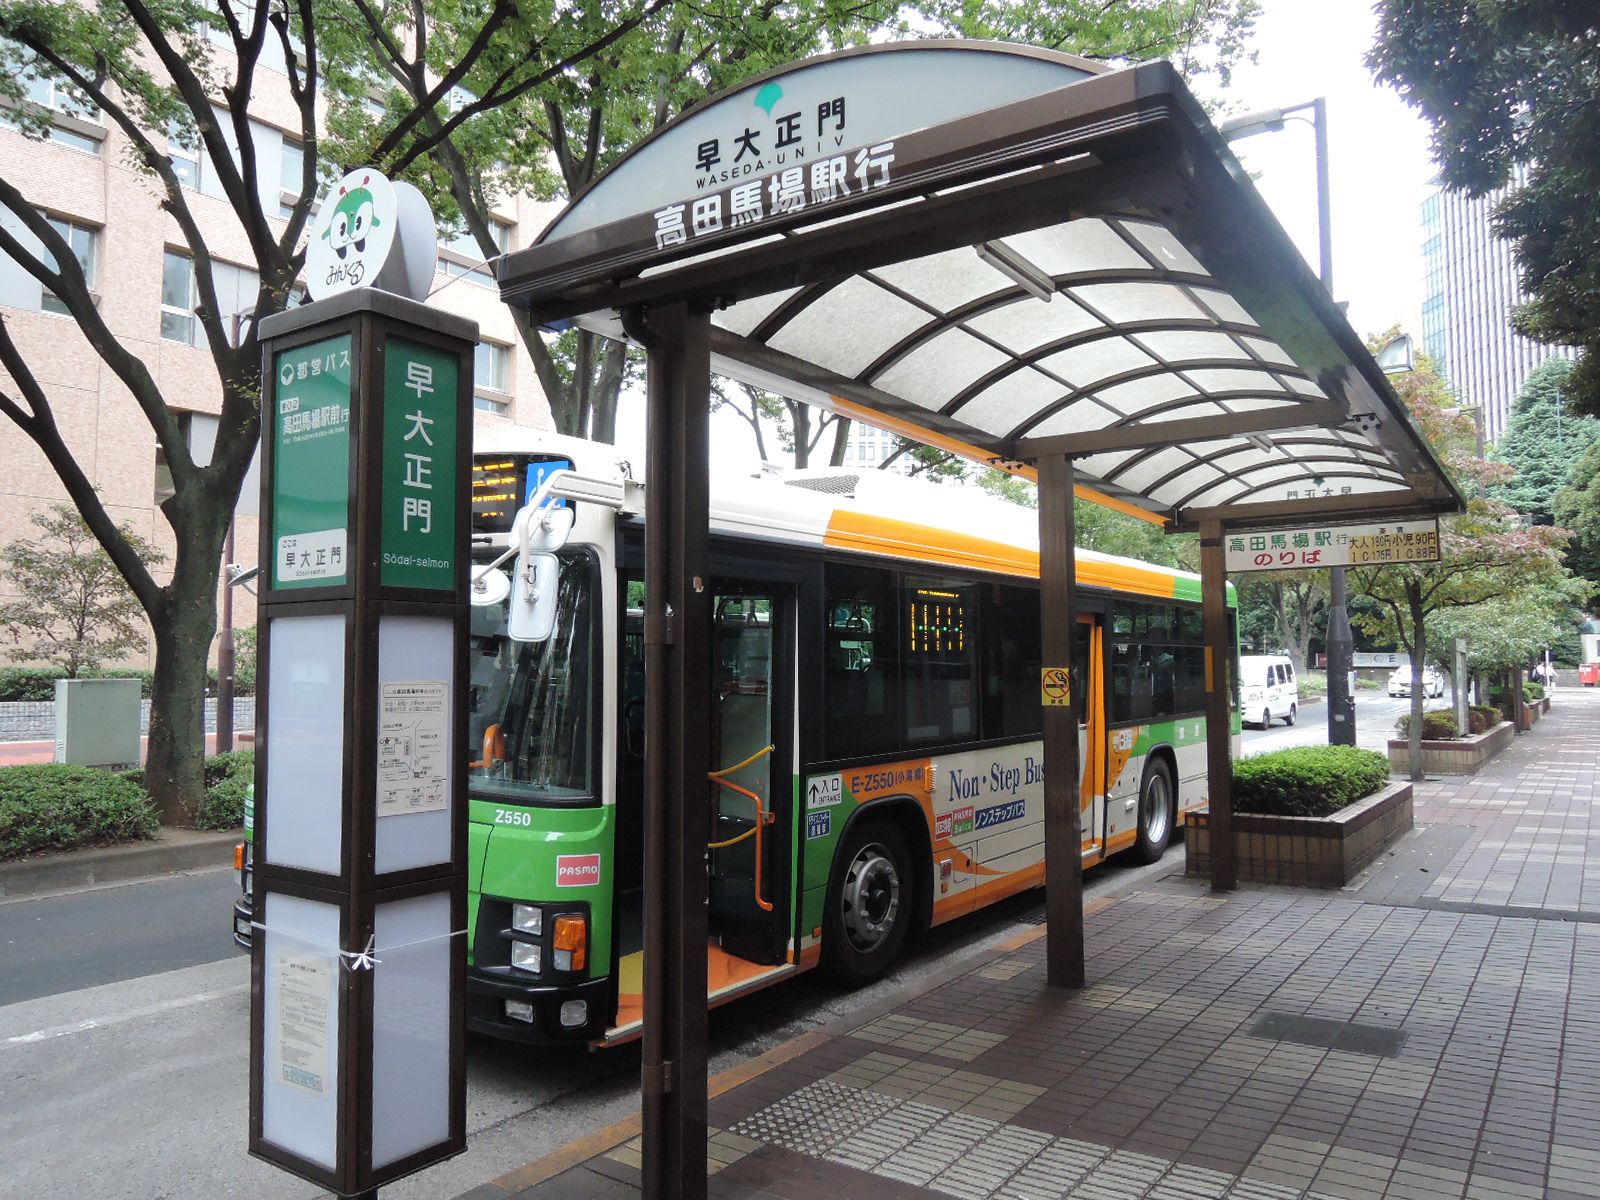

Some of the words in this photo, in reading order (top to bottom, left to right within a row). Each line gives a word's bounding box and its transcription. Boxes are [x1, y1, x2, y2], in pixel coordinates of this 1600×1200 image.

[695, 96, 846, 172] 早大正門
[654, 141, 896, 250] 高田馬場駅行
[297, 350, 351, 380] 都営バス
[403, 361, 435, 534] 早大正門
[1229, 531, 1348, 553] 高田馬場駅行
[286, 546, 341, 569] 早大正門
[1254, 549, 1322, 566] のりば
[821, 777, 839, 793] 入口
[495, 809, 532, 827] Z550
[975, 801, 1025, 828] ノンステップバス
[559, 864, 598, 876] PASMO
